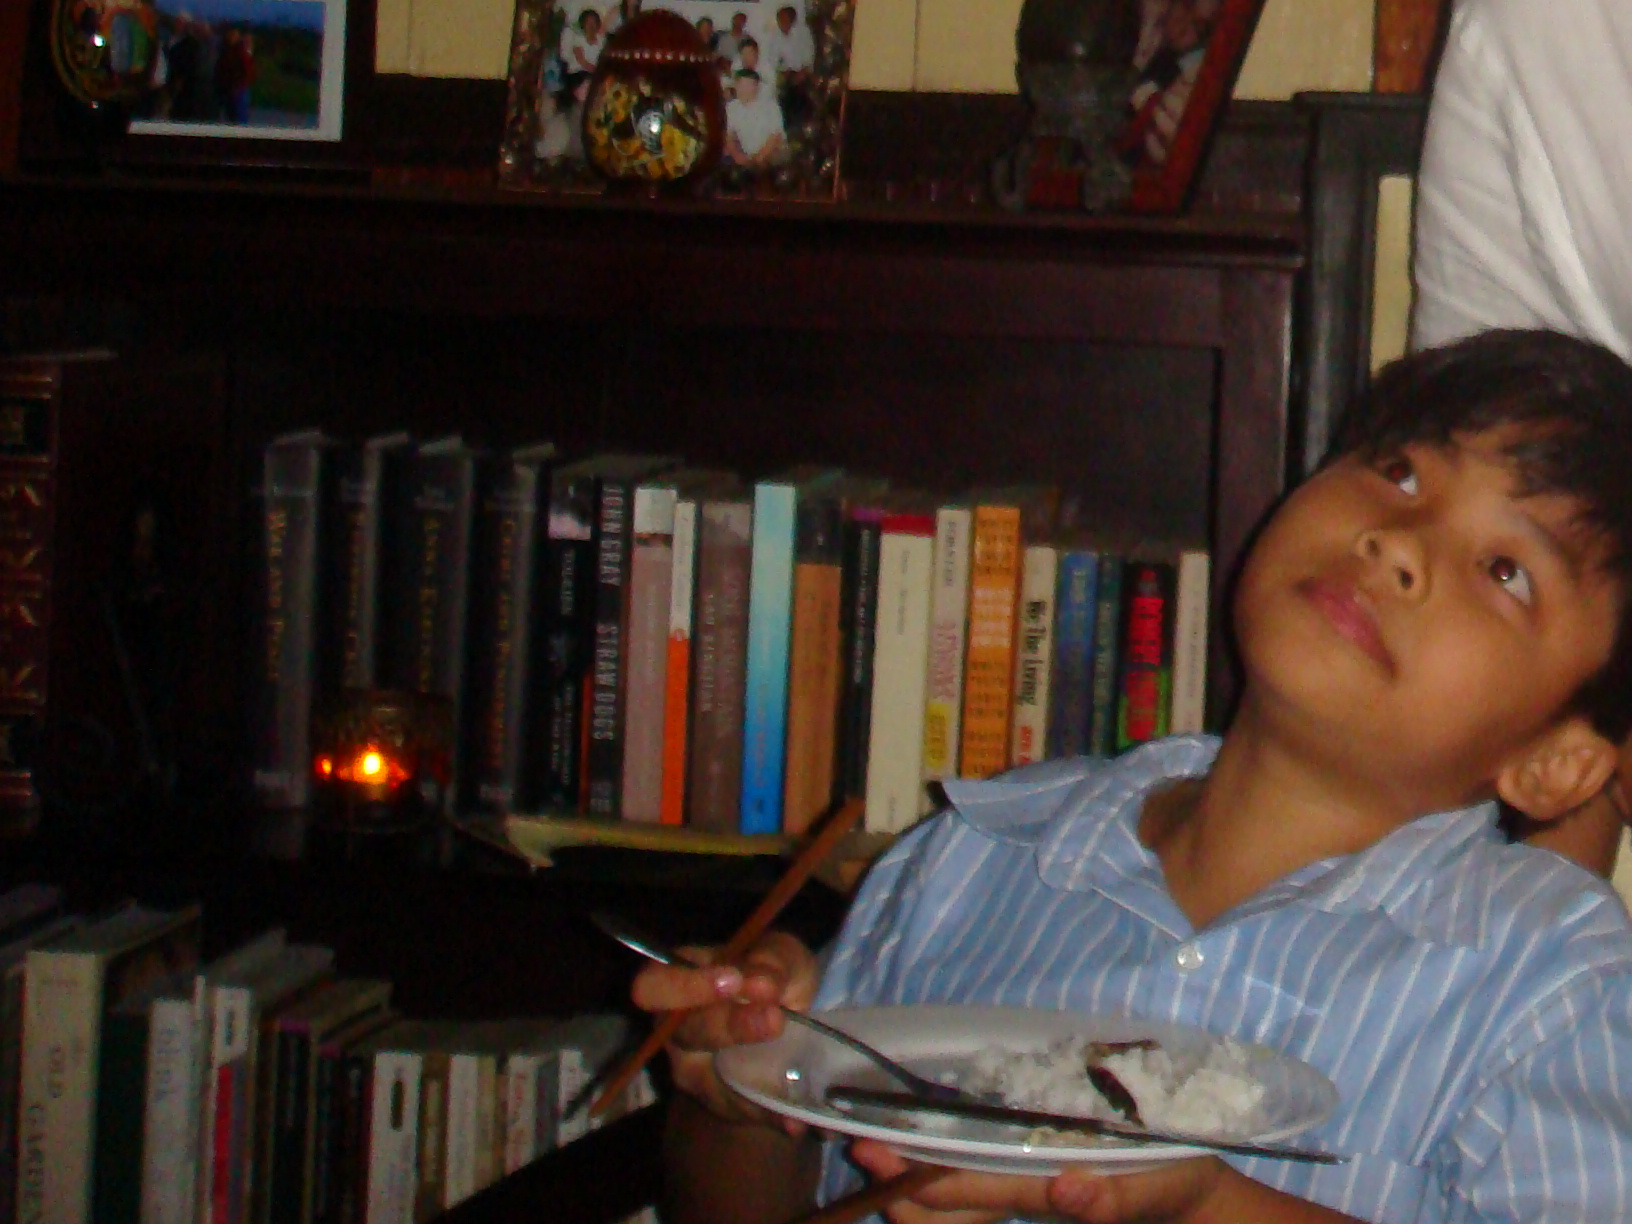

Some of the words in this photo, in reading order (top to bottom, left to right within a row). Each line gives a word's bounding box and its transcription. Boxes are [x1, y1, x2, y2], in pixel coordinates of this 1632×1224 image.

[601, 484, 624, 533] JOHN
[599, 538, 622, 587] GRAY
[595, 622, 619, 686] STRAW
[1027, 627, 1047, 654] The
[1017, 659, 1046, 707] Living
[592, 691, 616, 742] DOGS
